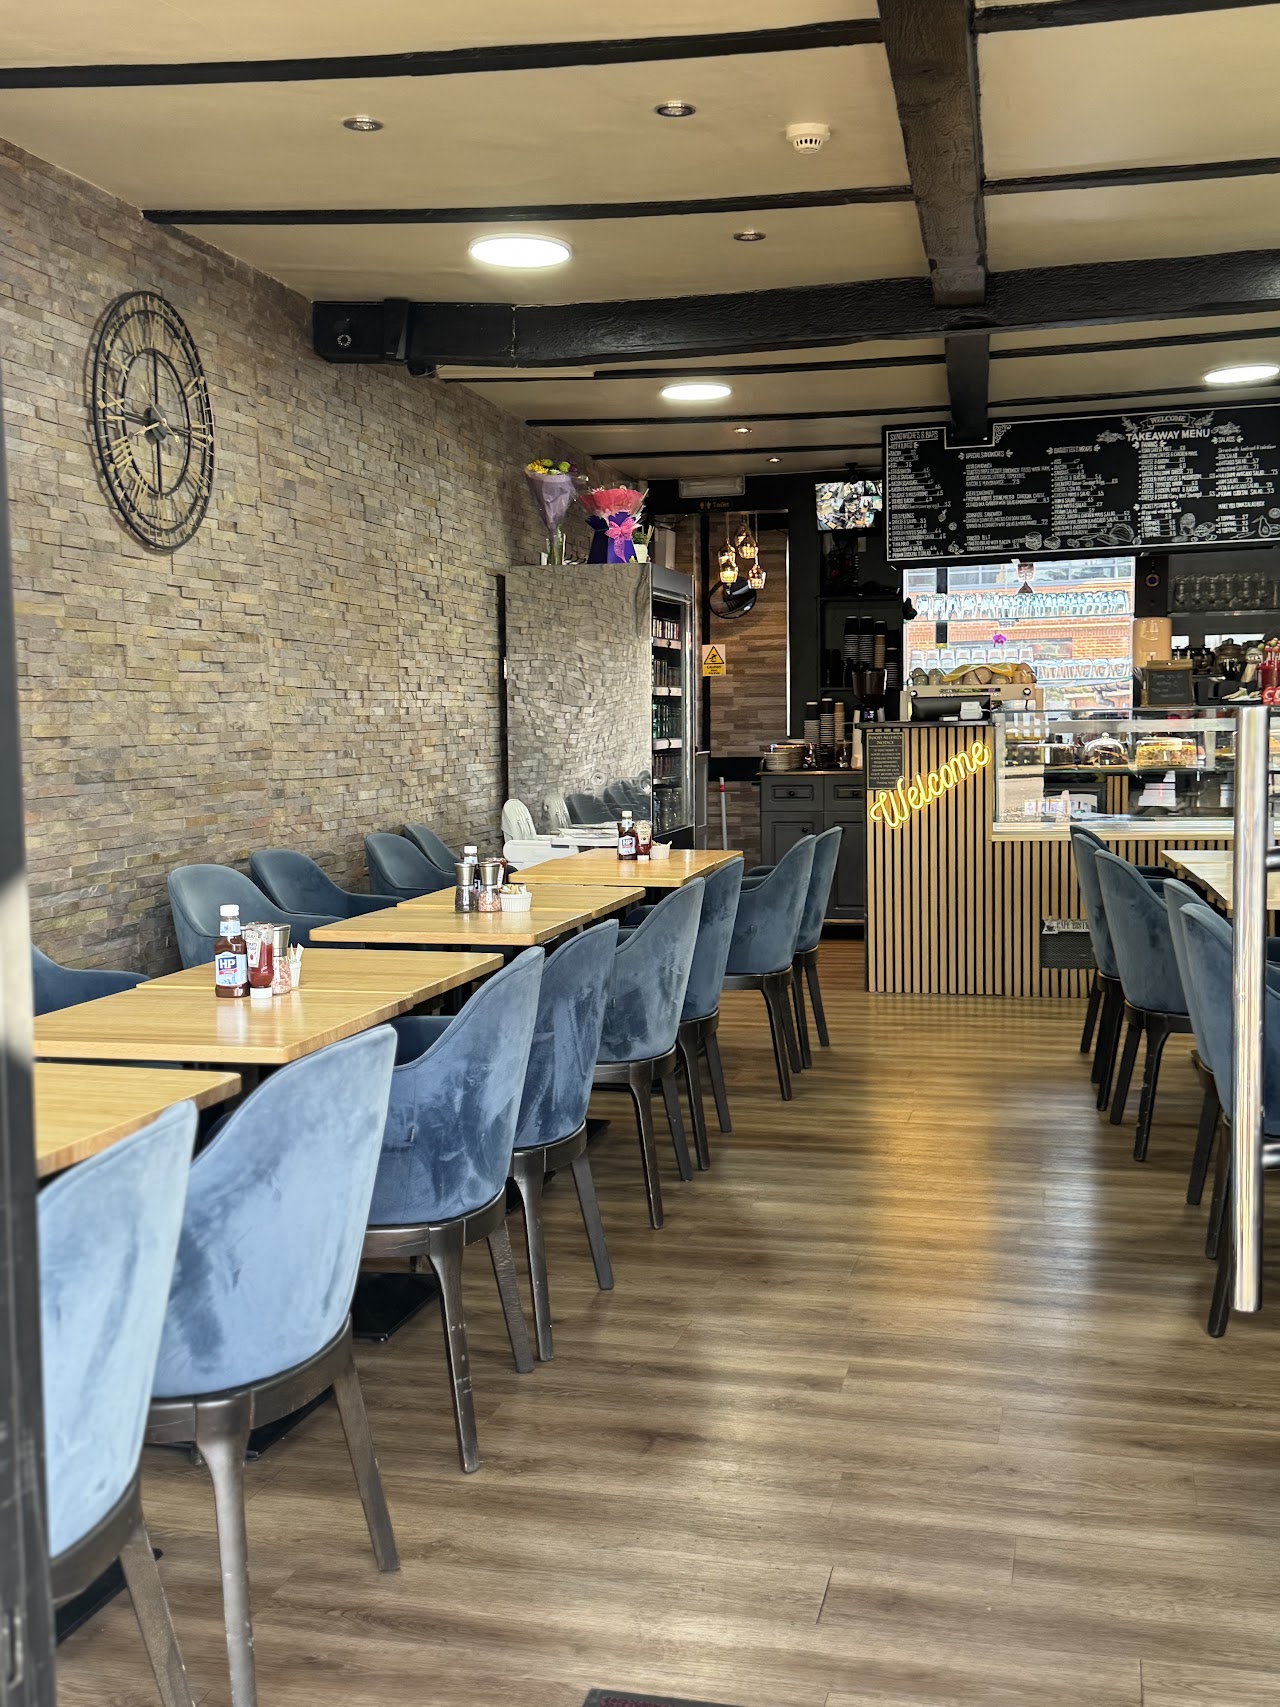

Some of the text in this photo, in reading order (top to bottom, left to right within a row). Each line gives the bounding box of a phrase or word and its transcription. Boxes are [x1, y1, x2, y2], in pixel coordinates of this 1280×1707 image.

[1149, 416, 1187, 424] WELCOME
[1126, 428, 1211, 441] TAKEAWAY MENU
[869, 740, 991, 828] Welcome
[219, 959, 236, 968] HP
